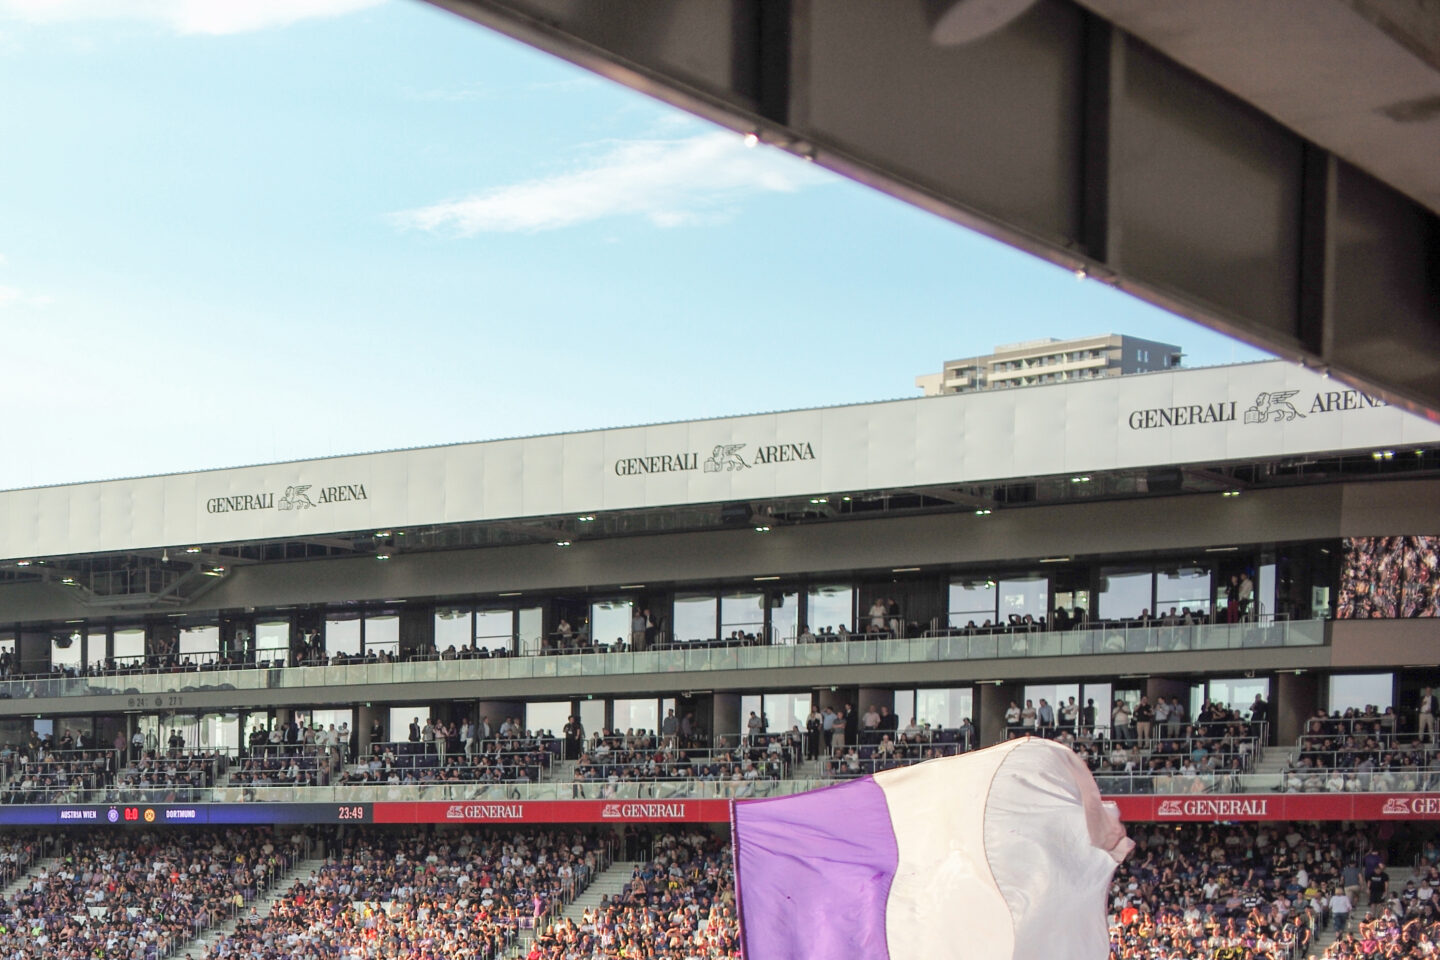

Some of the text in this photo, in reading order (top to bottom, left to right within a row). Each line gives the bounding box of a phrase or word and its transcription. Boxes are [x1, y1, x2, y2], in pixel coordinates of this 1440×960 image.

[1128, 401, 1238, 430] GENERALI
[615, 442, 816, 477] GENERALI ARENA
[206, 483, 367, 514] GENERALI ARENA
[338, 806, 363, 820] 23:49
[464, 804, 523, 818] GENERALI
[622, 804, 685, 818] GENERALI
[1184, 799, 1267, 816] GENERALI
[1412, 798, 1440, 814] GE
[83, 810, 96, 818] WIEN
[124, 807, 139, 820] 0:0
[166, 810, 196, 818] DORTMUND
